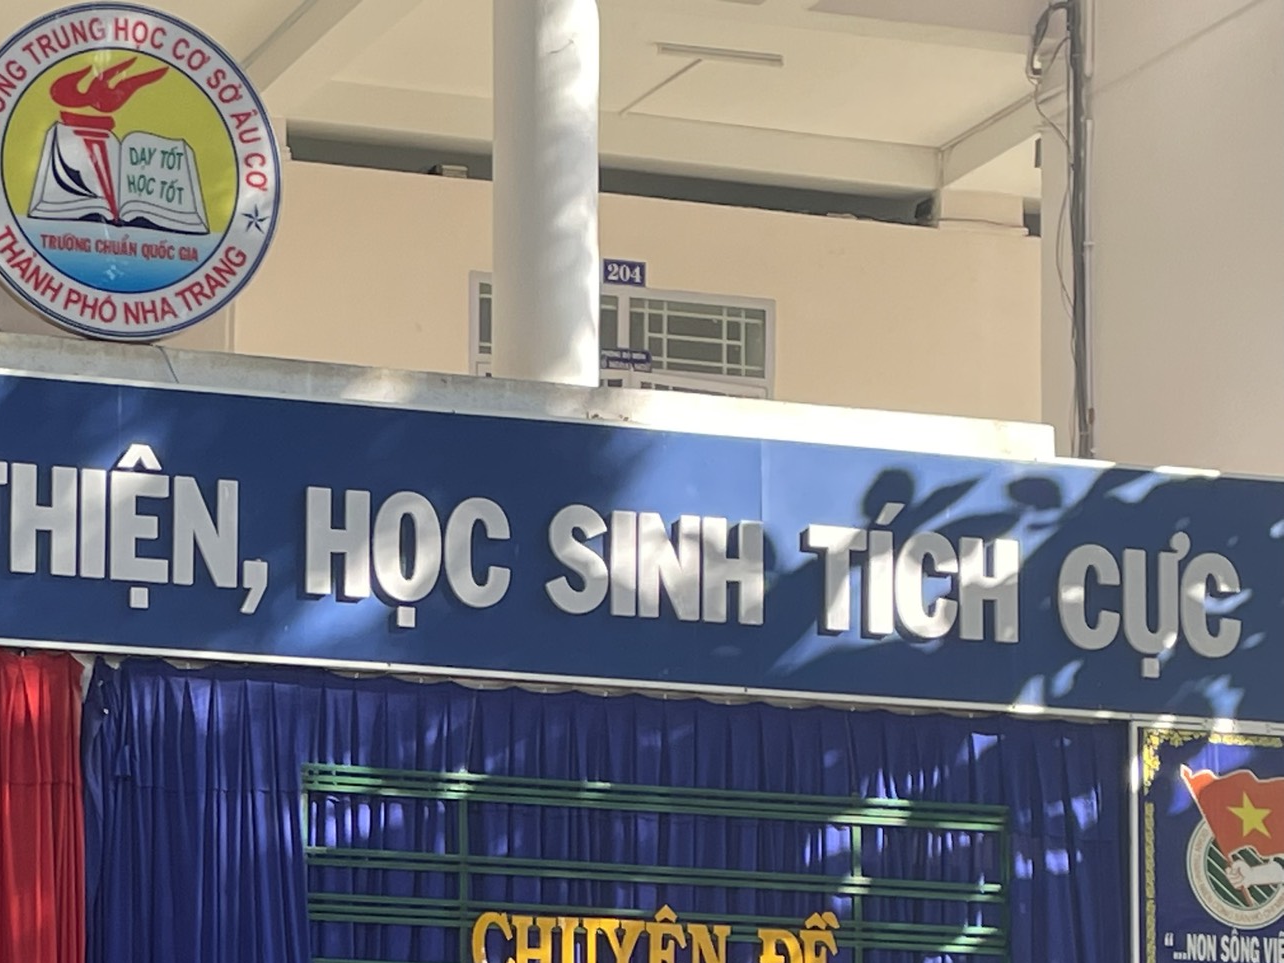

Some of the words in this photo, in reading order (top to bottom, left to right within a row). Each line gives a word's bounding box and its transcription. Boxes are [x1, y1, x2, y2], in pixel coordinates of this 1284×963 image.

[22, 17, 107, 66] TRUNG
[113, 17, 167, 51] HỌC
[171, 38, 211, 72] CƠ
[206, 68, 244, 104] SỞ
[231, 109, 262, 145] ÂU
[129, 147, 156, 167] DẠY
[161, 147, 185, 171] TỐT
[243, 152, 268, 193] CƠ
[127, 174, 155, 196] HỌC
[159, 179, 186, 206] TỐT
[40, 233, 92, 252] TRƯỜNG
[141, 239, 175, 260] QUỐC
[178, 245, 199, 262] GIA
[62, 288, 117, 325] PHỐ
[123, 300, 178, 326] NHA
[175, 244, 248, 313] TRANG
[607, 263, 642, 283] 204
[304, 485, 512, 629] HỌC
[545, 503, 765, 626] SINH
[804, 501, 1020, 644] TÍCH
[1057, 531, 1243, 679] CỰC
[1220, 928, 1261, 963] SÔNG
